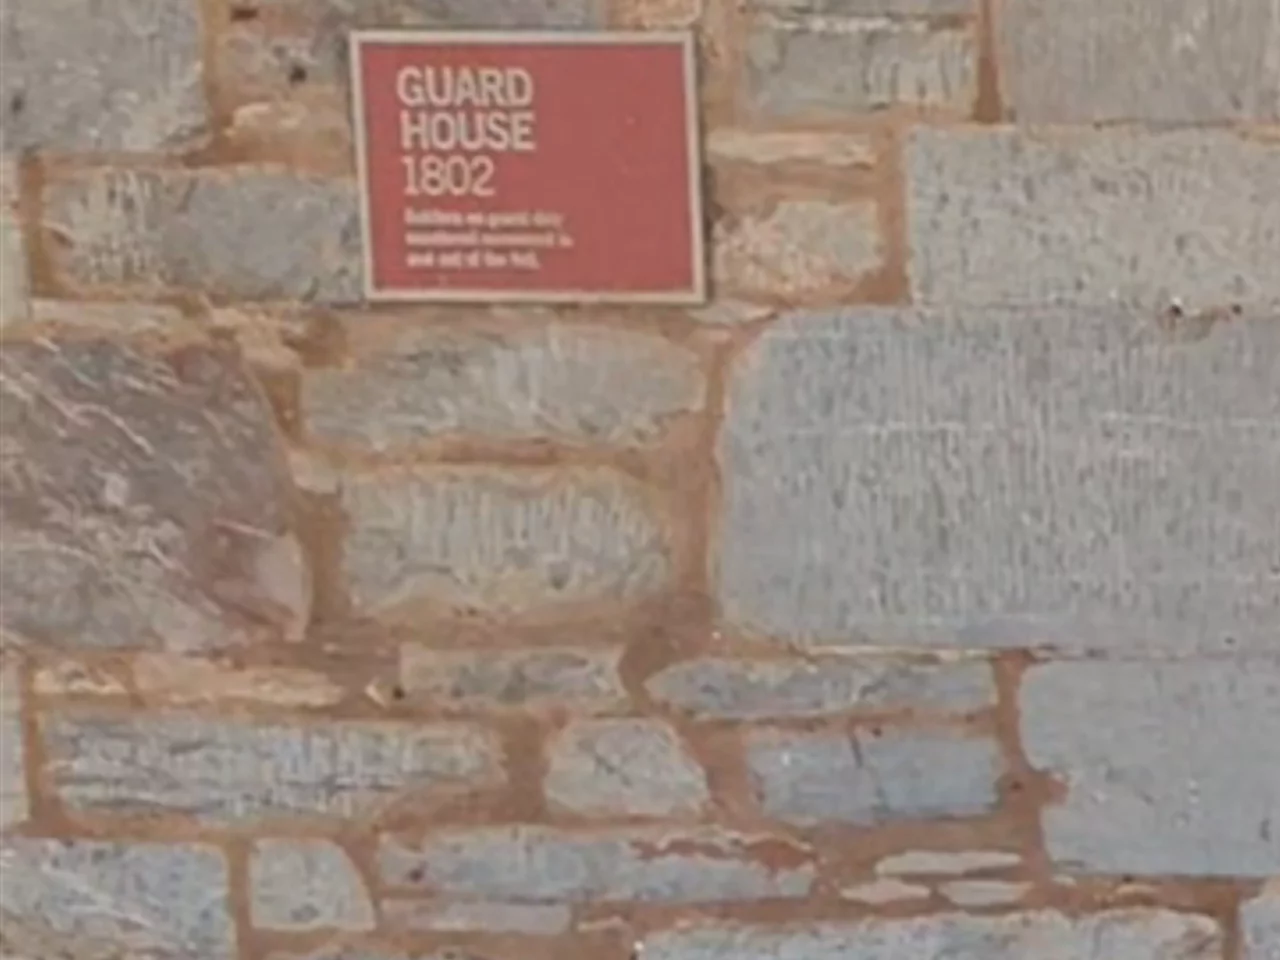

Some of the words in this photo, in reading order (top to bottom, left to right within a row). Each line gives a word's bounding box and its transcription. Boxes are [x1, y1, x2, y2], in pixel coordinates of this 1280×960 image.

[397, 65, 534, 107] GUARD
[400, 109, 537, 151] HOUSE
[401, 155, 496, 197] 1802
